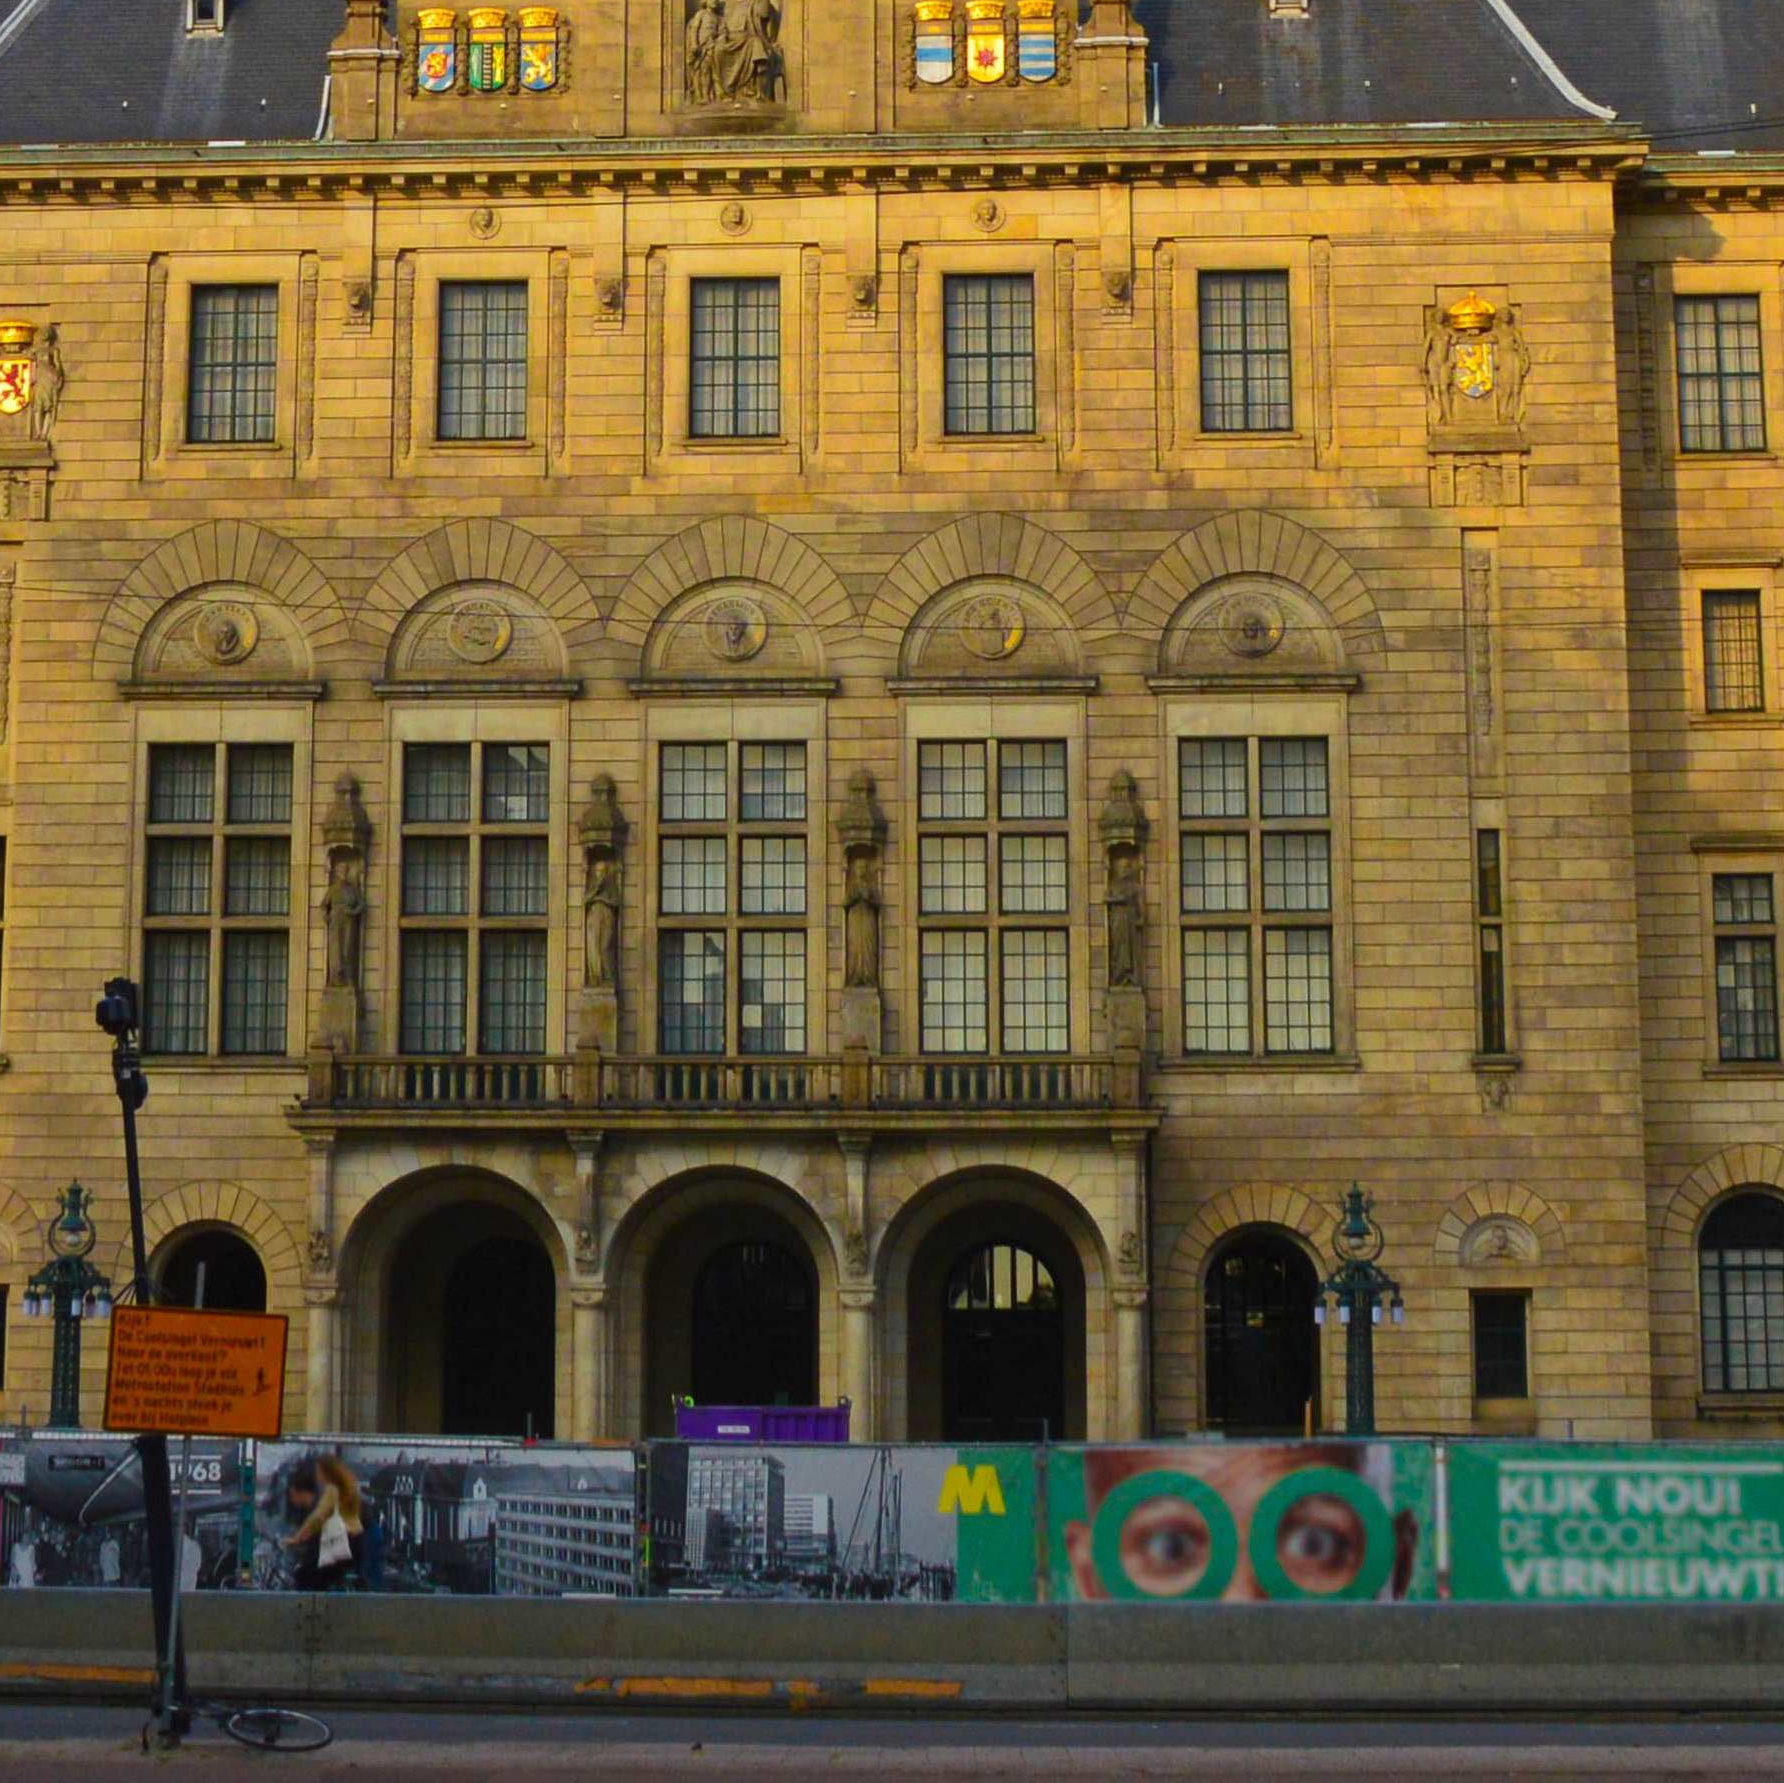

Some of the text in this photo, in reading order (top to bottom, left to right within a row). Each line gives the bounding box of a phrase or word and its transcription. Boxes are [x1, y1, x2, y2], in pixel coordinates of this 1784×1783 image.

[169, 1461, 222, 1482] 1968
[1498, 1476, 1742, 1515] KIJK NOU!
[1501, 1518, 1781, 1555] DE COOLSINGEL
